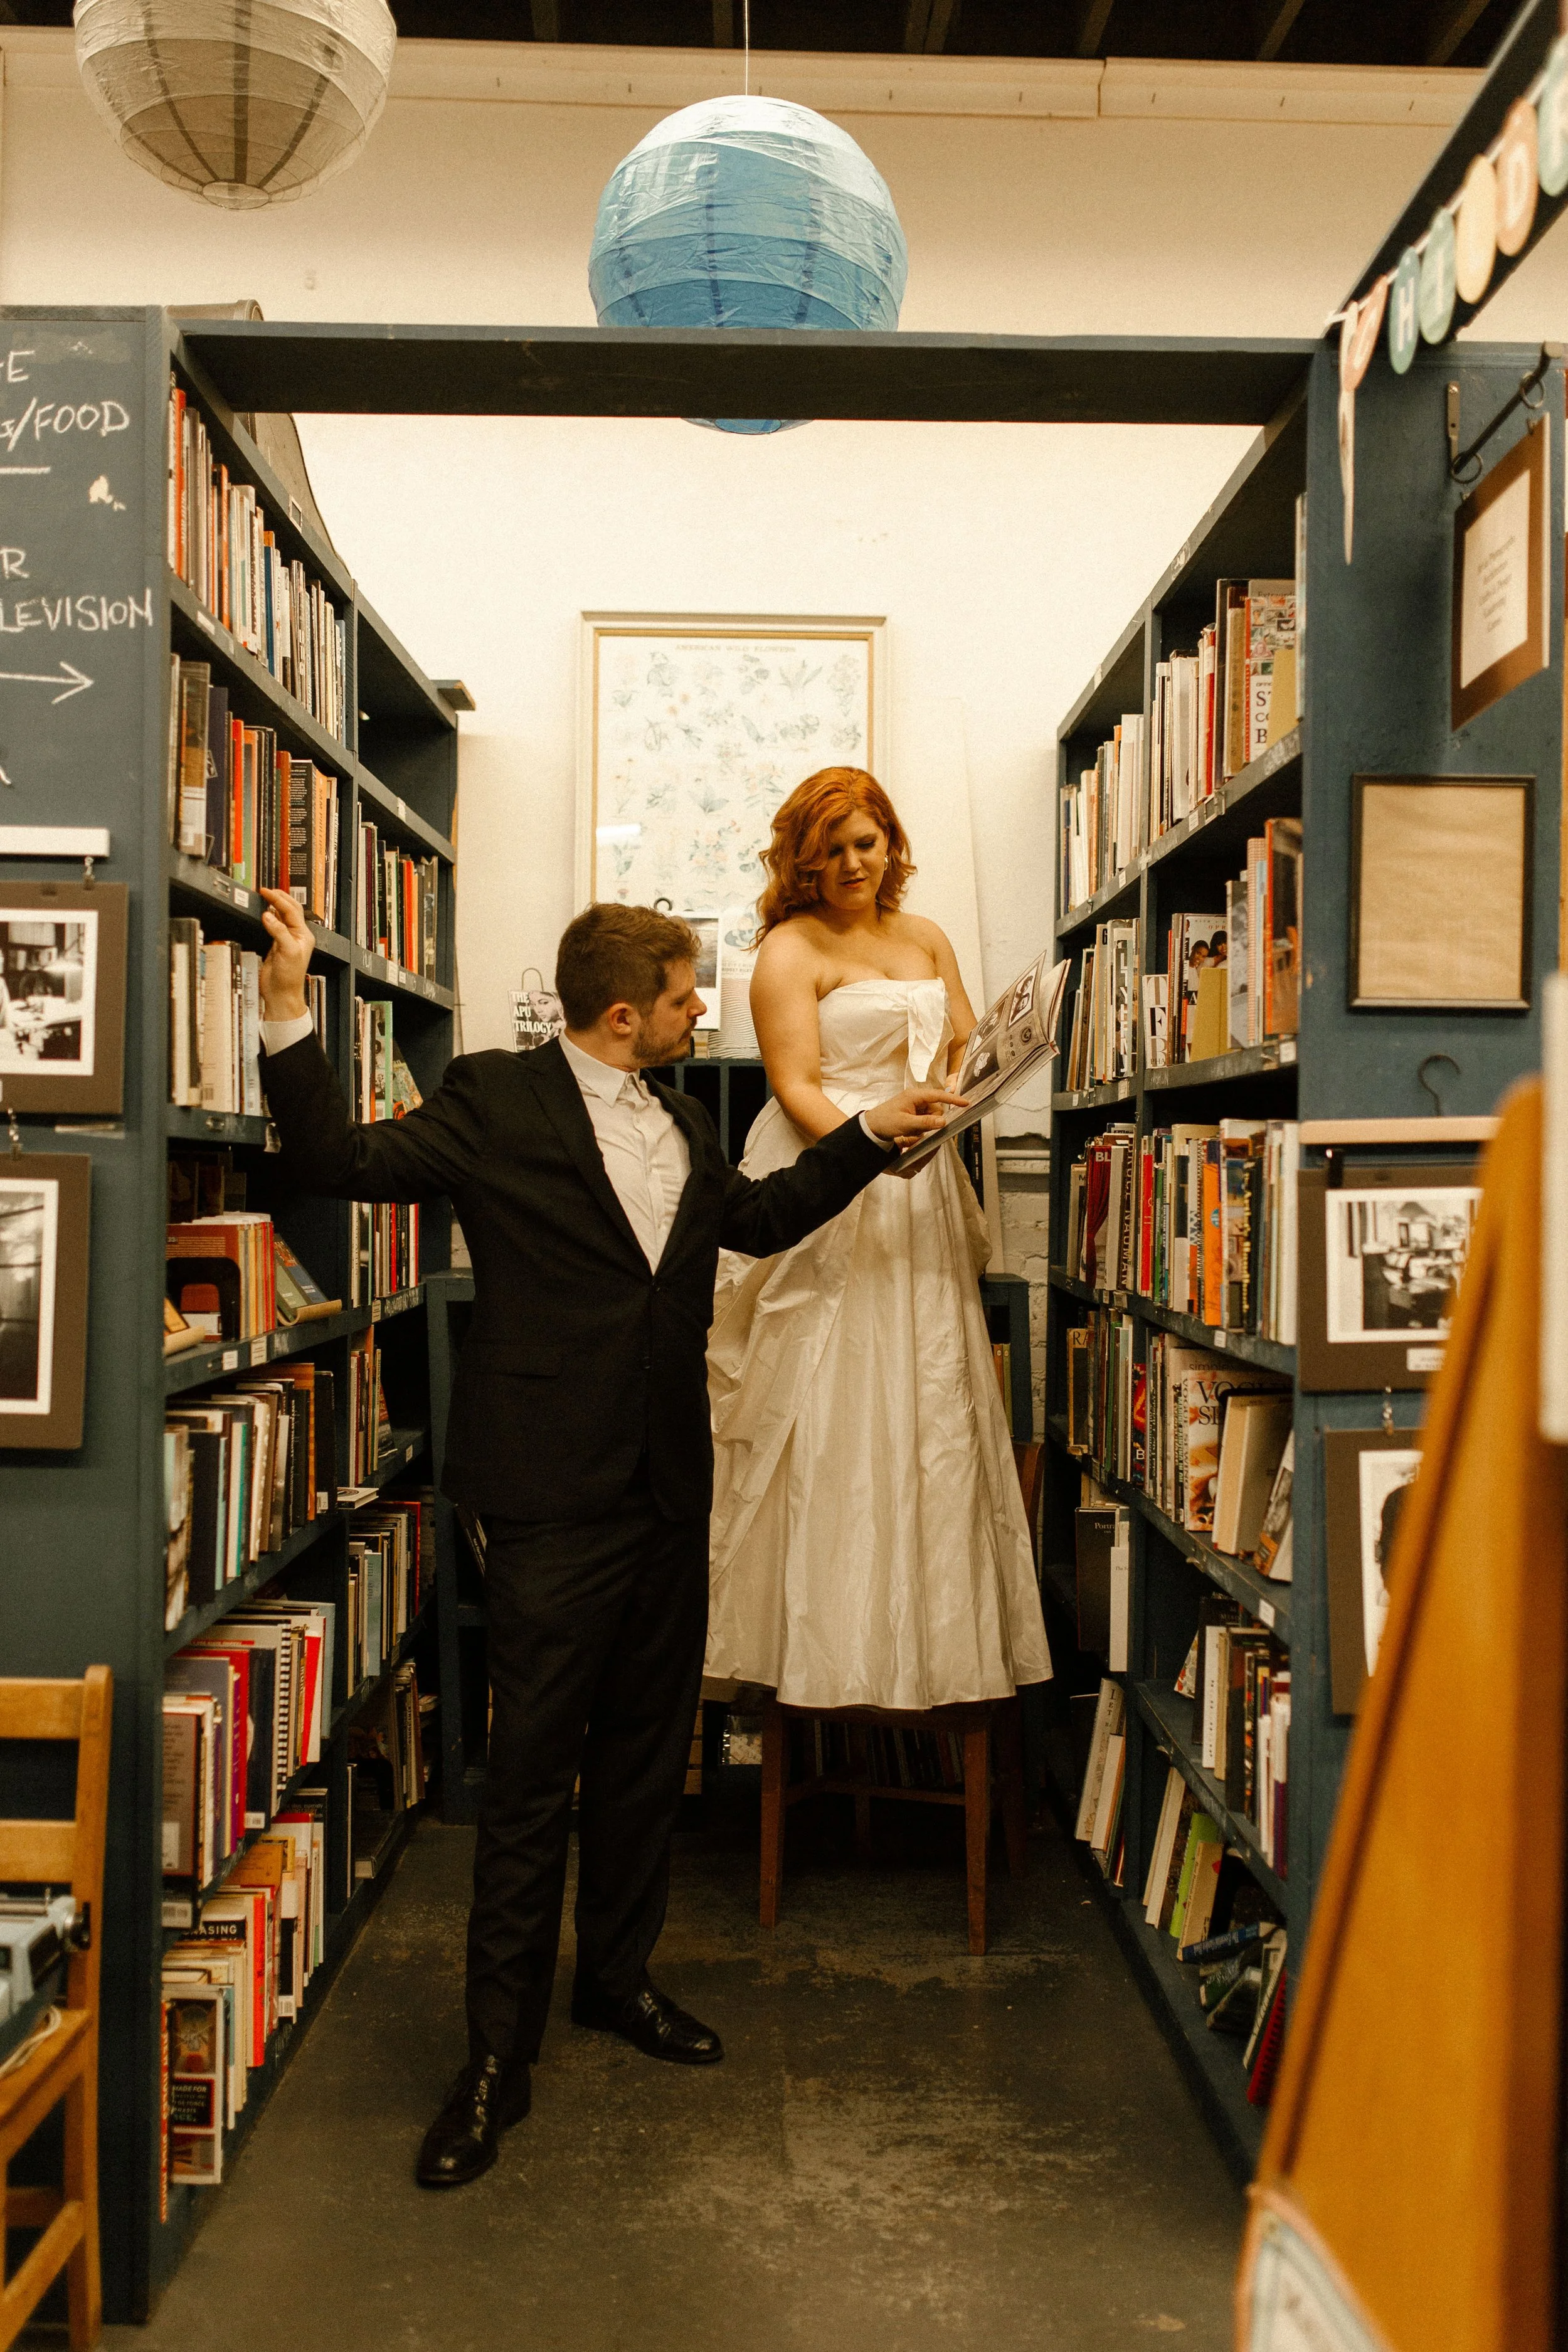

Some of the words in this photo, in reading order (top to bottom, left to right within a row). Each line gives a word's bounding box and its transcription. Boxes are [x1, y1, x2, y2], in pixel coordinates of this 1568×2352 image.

[513, 992, 530, 1004] THE
[514, 1005, 531, 1017] APU
[514, 1020, 553, 1034] TRILOGY
